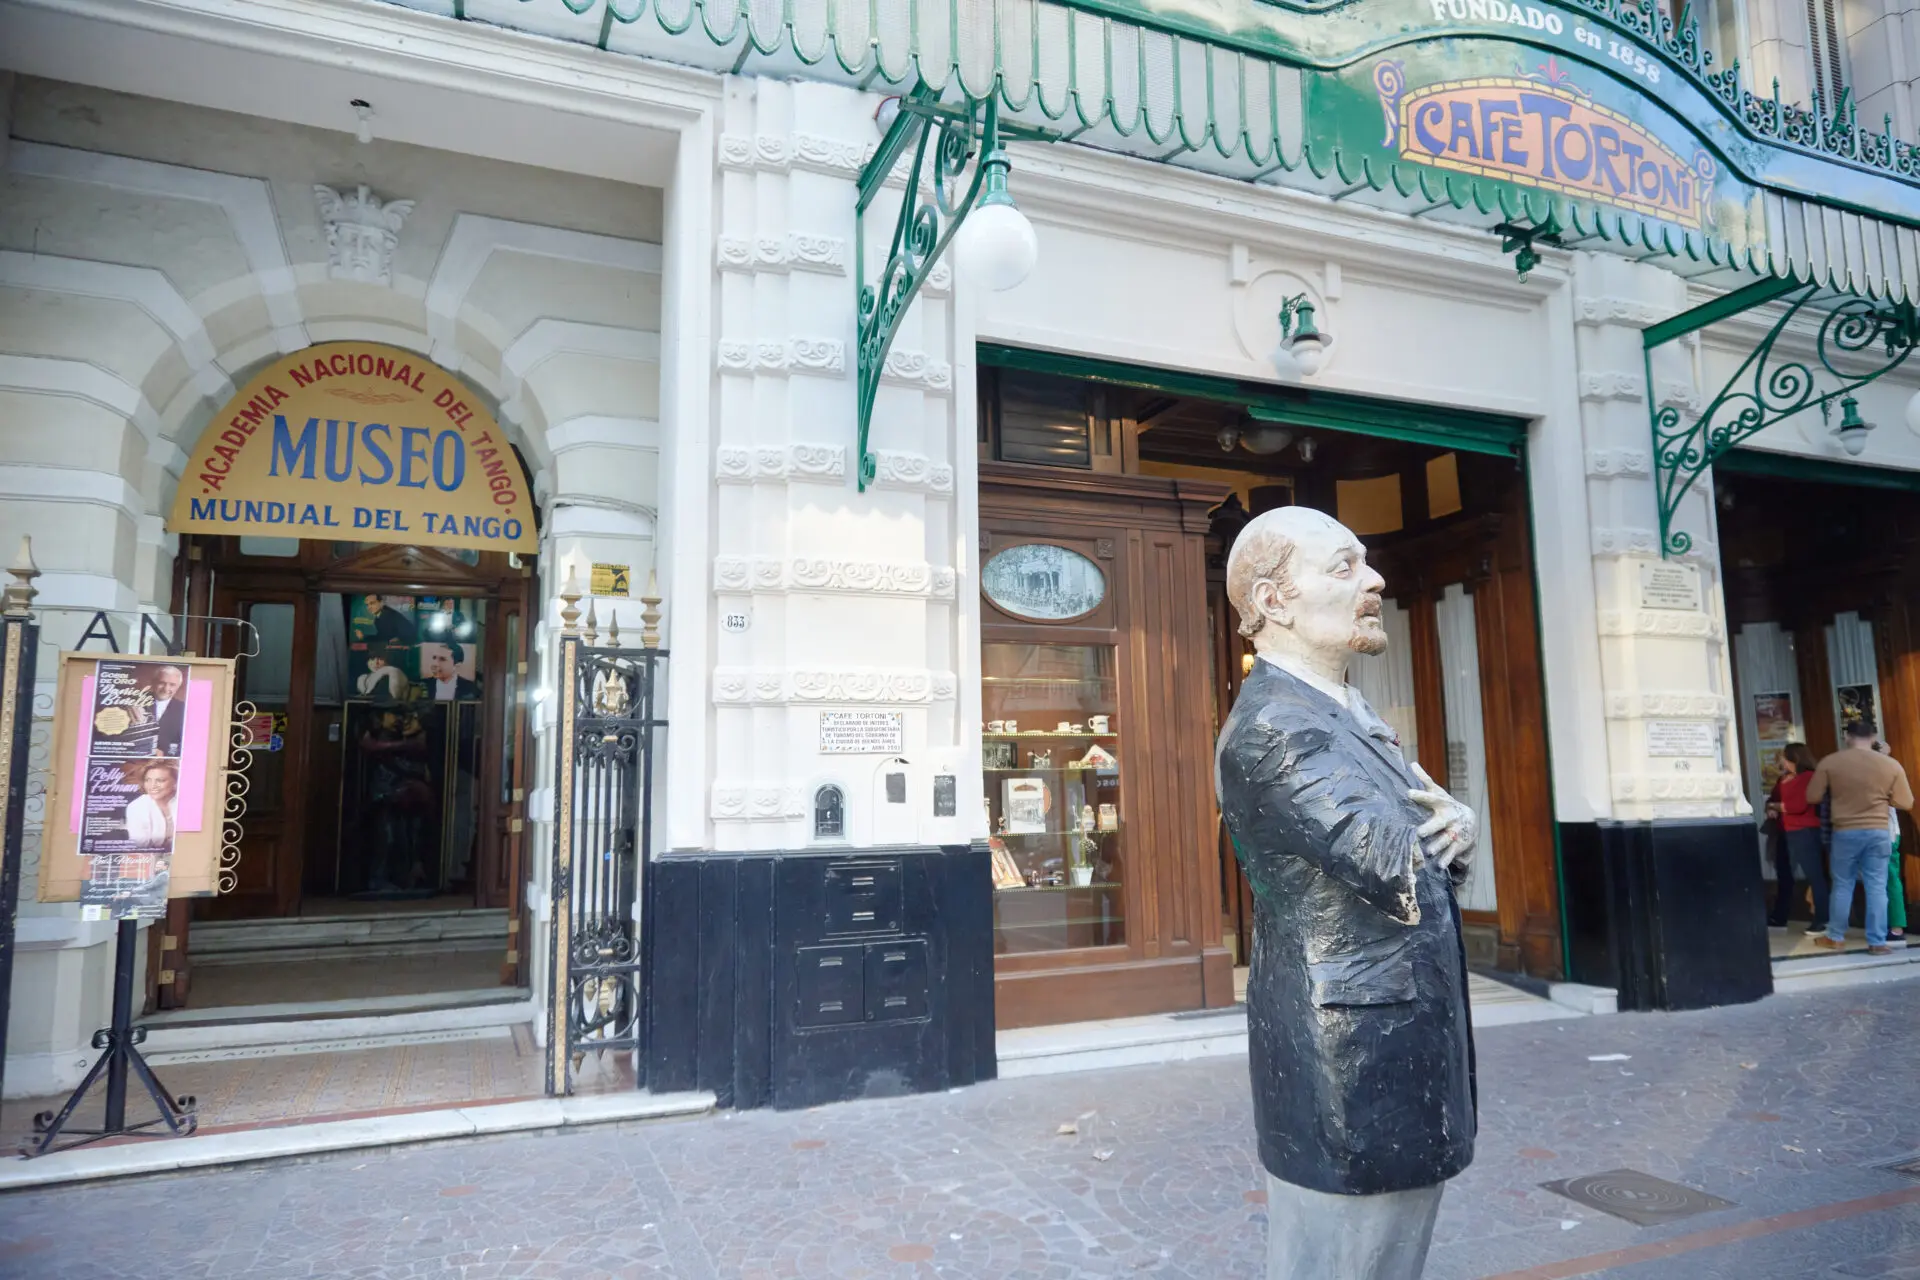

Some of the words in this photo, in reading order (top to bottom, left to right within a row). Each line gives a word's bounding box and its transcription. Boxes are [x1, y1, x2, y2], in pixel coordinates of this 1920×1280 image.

[1430, 0, 1563, 35] FUNDADO
[1574, 27, 1603, 50] en
[1608, 41, 1661, 83] 1858
[1415, 100, 1529, 168] CAFE
[1519, 93, 1691, 210] TORTONI
[200, 384, 290, 492] ACADEMIA
[288, 354, 426, 393] NACIONAL
[433, 388, 475, 431] DEL
[470, 431, 517, 506] TANGO
[268, 414, 466, 492] MUSEO
[190, 497, 339, 527] MUNDIAL
[353, 507, 409, 532] DEL
[422, 512, 522, 540] TANGO
[727, 615, 745, 628] 833
